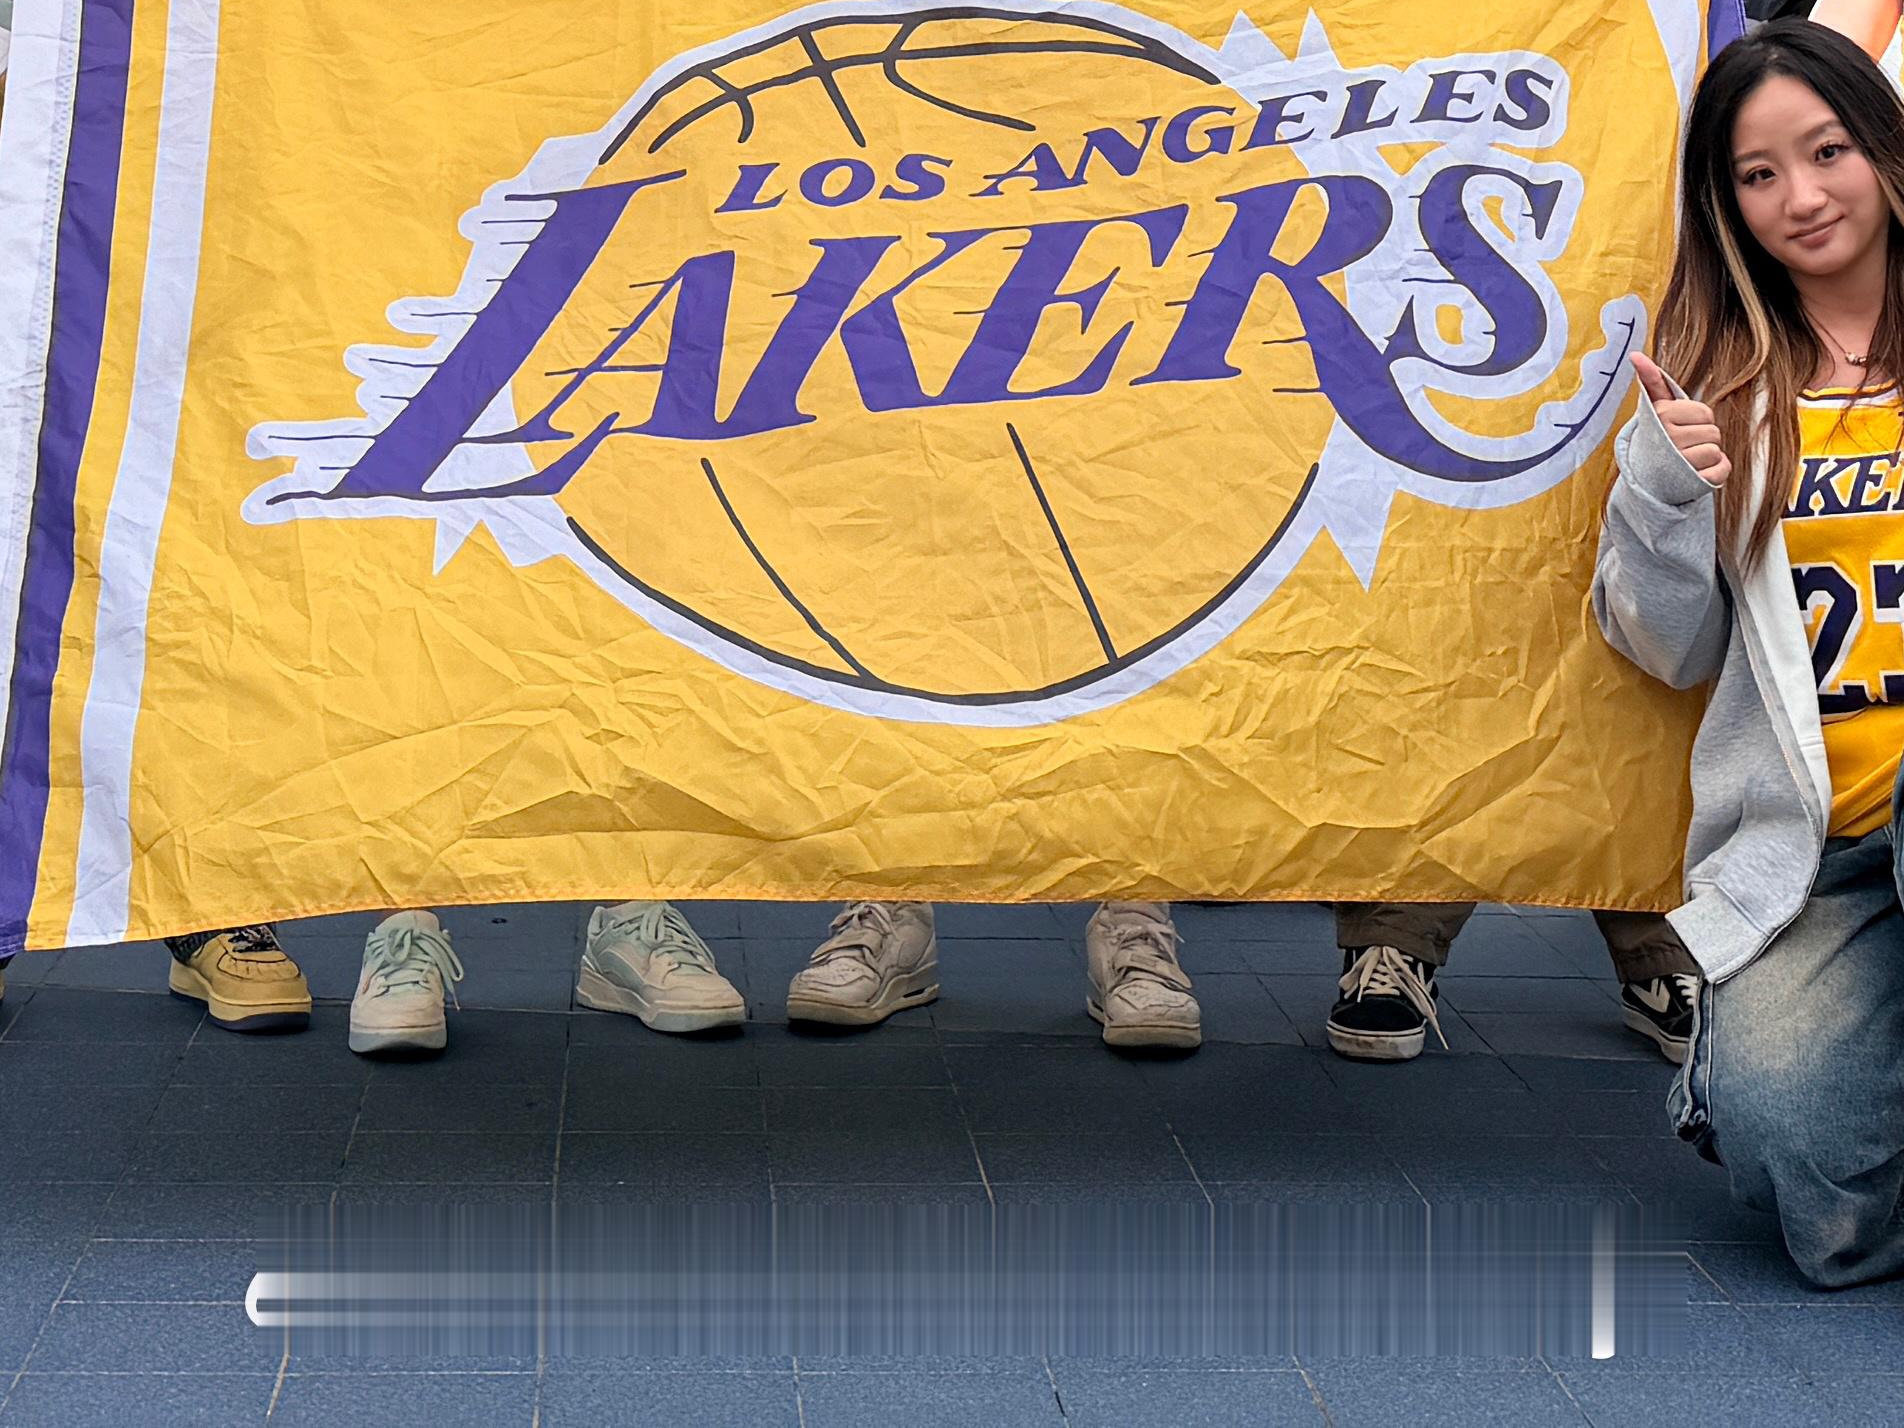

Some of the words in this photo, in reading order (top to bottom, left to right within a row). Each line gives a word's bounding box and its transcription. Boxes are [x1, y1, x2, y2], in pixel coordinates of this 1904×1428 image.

[714, 153, 956, 214] LOS
[981, 66, 1557, 195] ANGELES
[267, 162, 1637, 504] LAKERS
